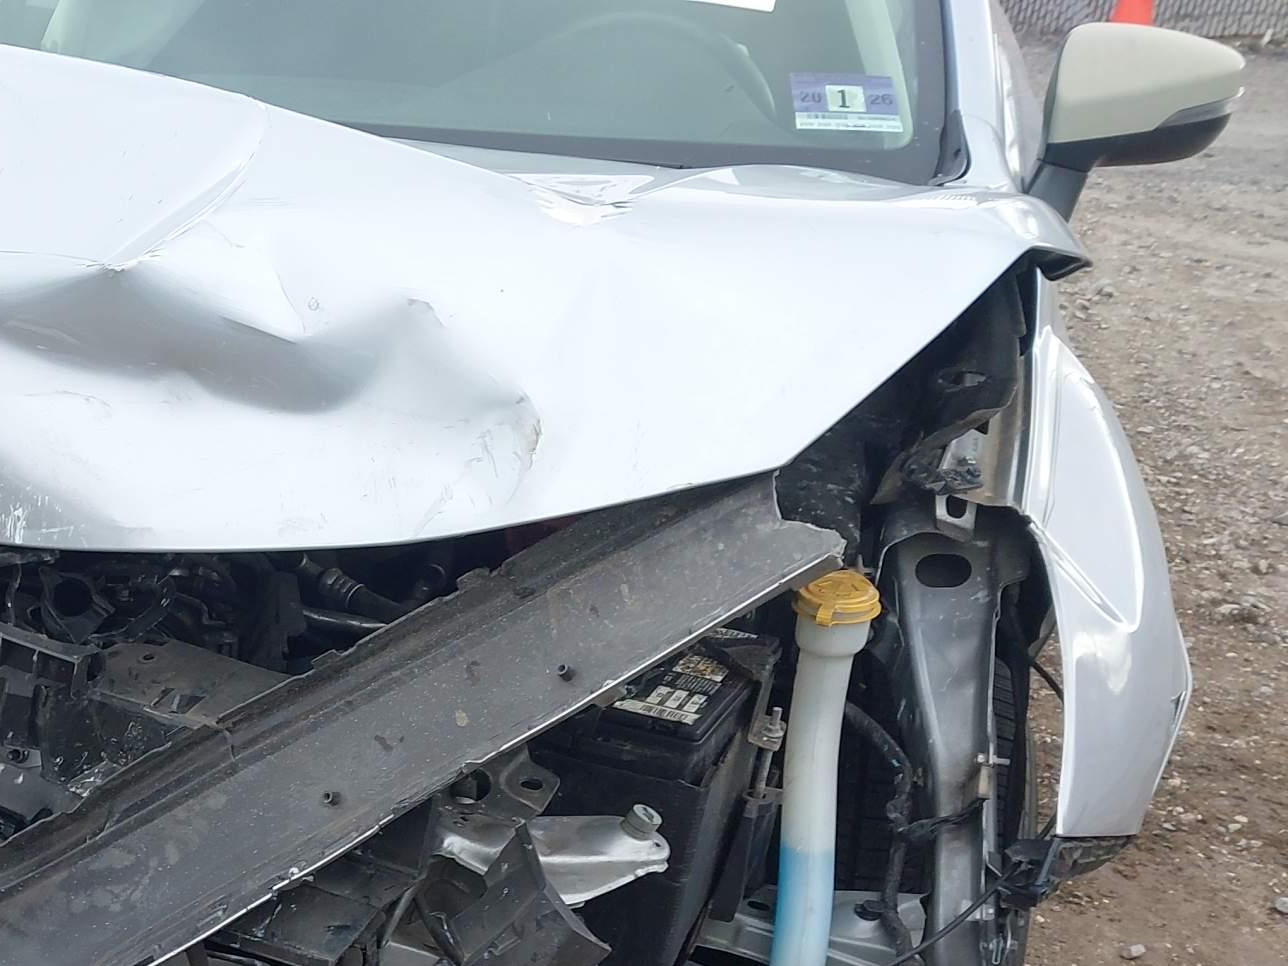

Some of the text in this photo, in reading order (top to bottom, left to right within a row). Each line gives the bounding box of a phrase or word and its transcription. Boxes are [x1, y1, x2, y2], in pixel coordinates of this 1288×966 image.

[800, 89, 893, 109] 20 1 26
